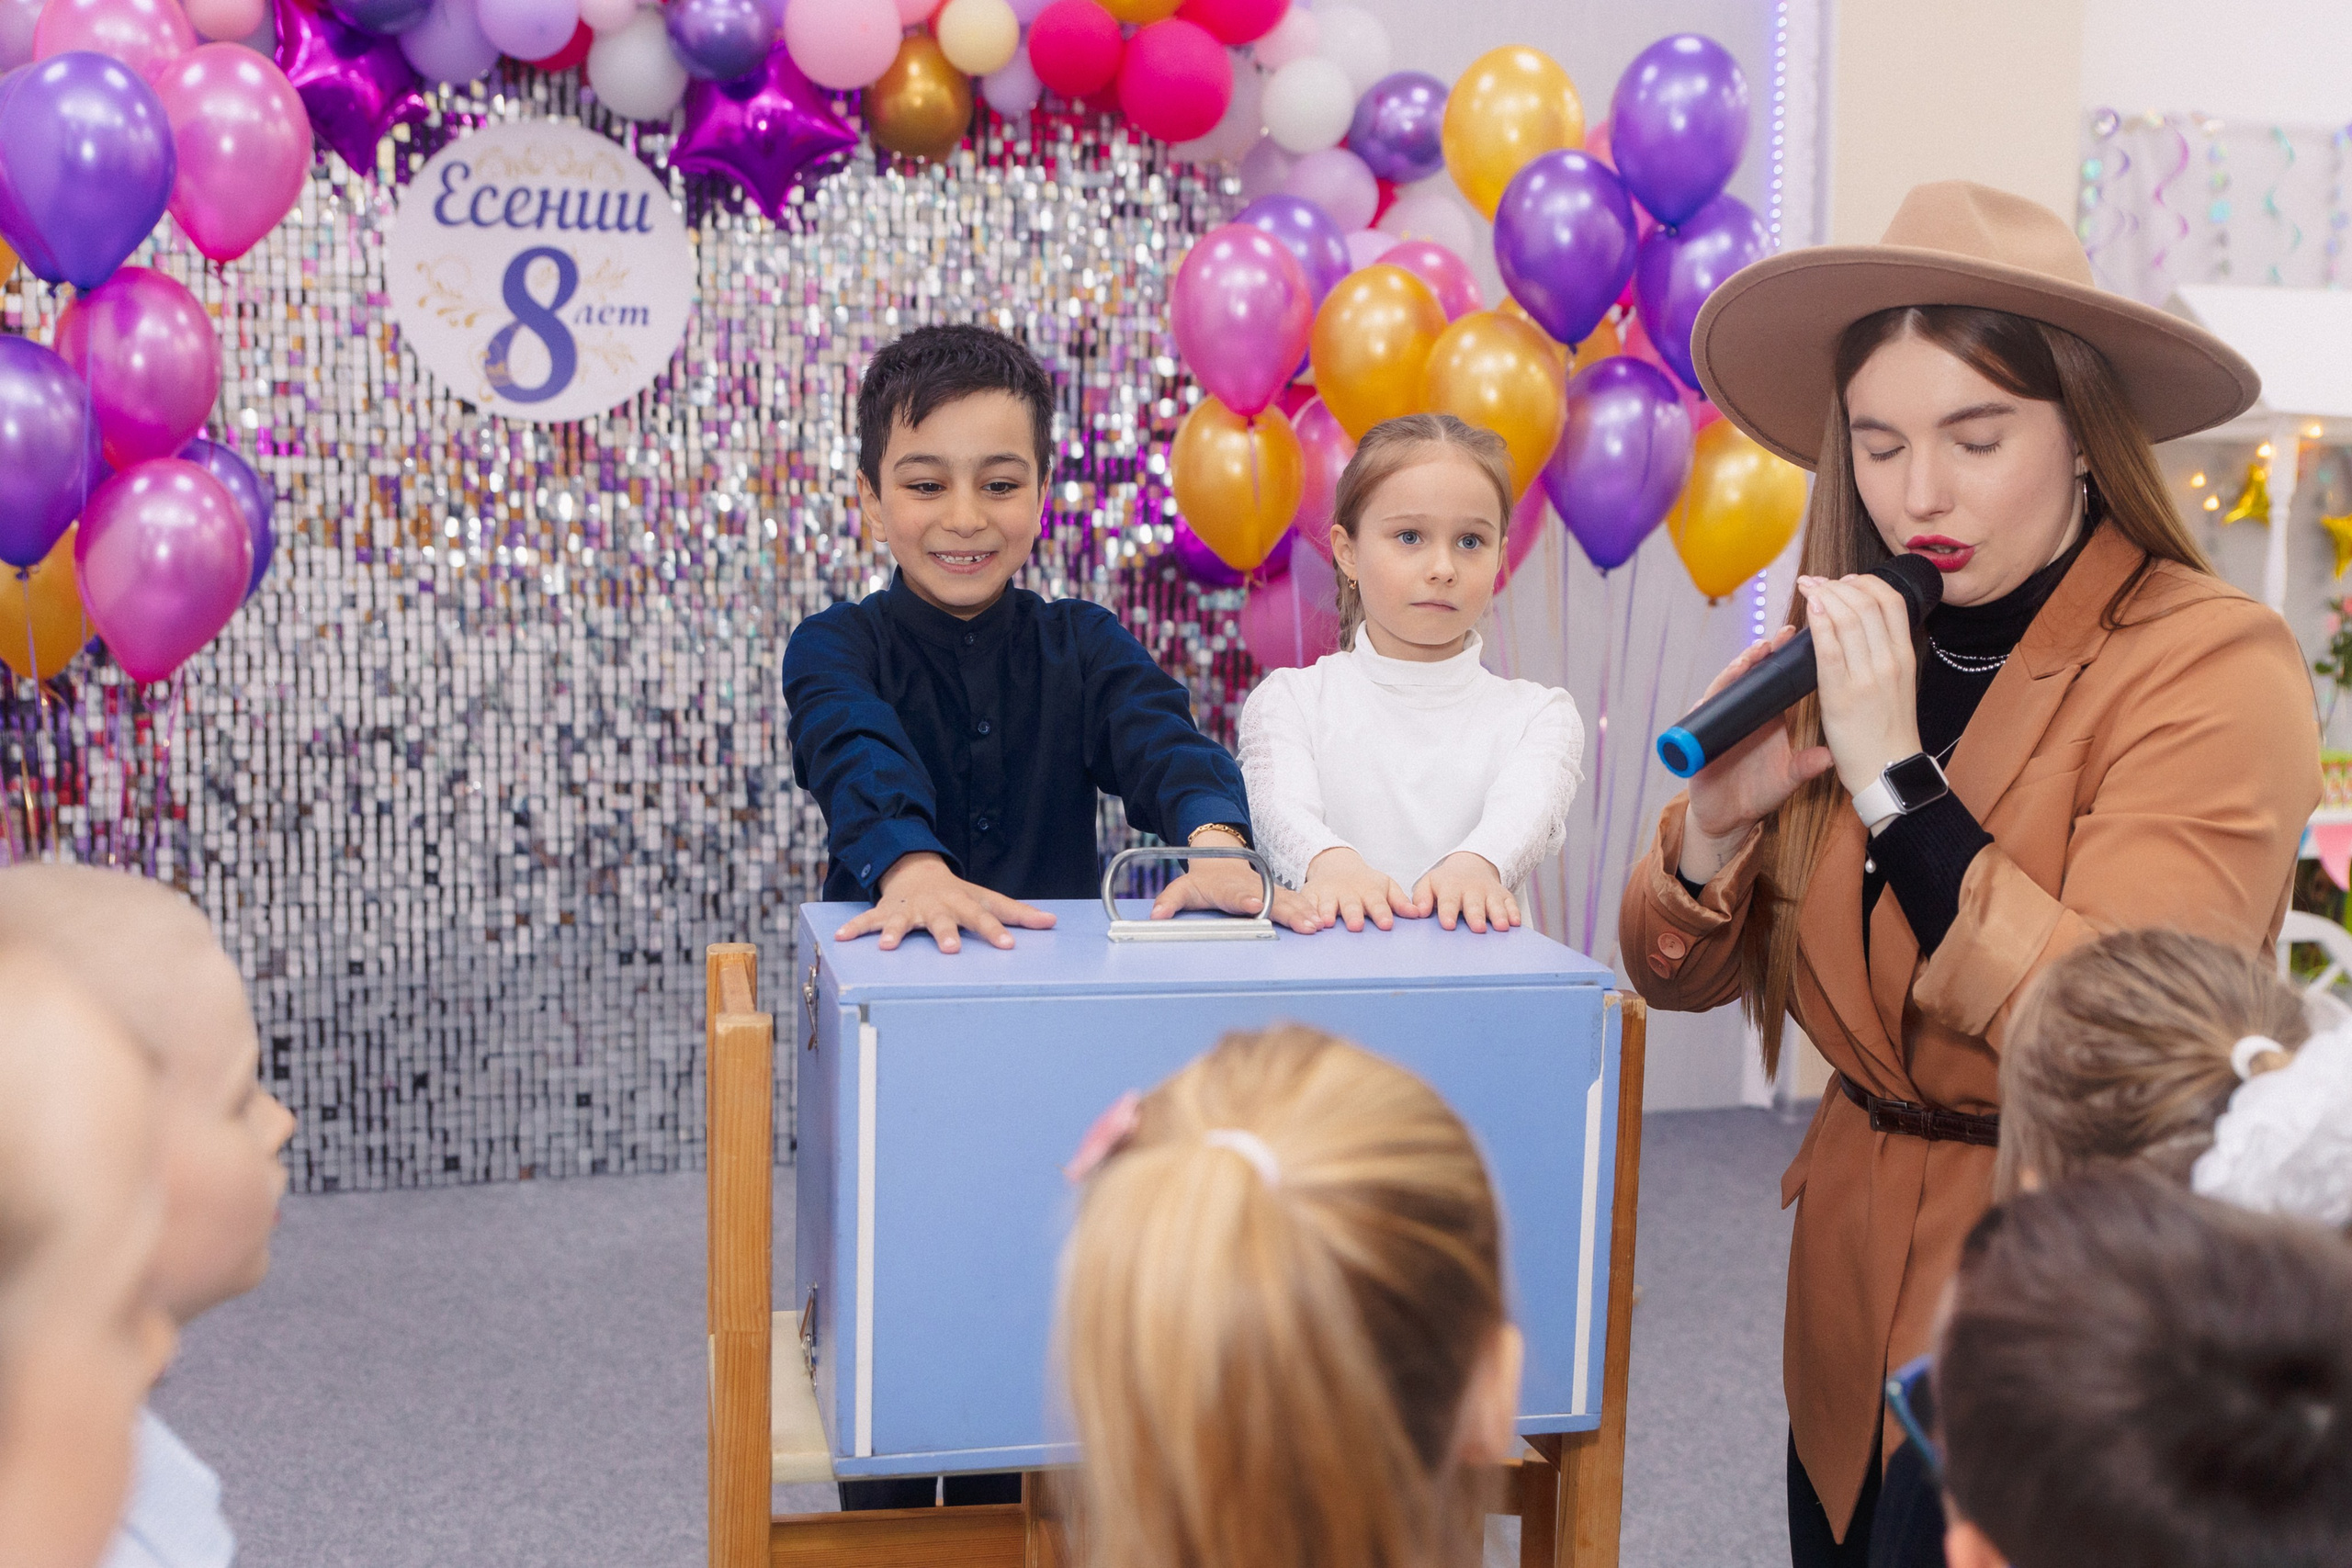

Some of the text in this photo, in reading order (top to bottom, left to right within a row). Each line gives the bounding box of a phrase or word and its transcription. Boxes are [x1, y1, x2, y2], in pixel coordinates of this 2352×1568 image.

[434, 161, 653, 233] Есении
[485, 244, 650, 404] 8 лет
